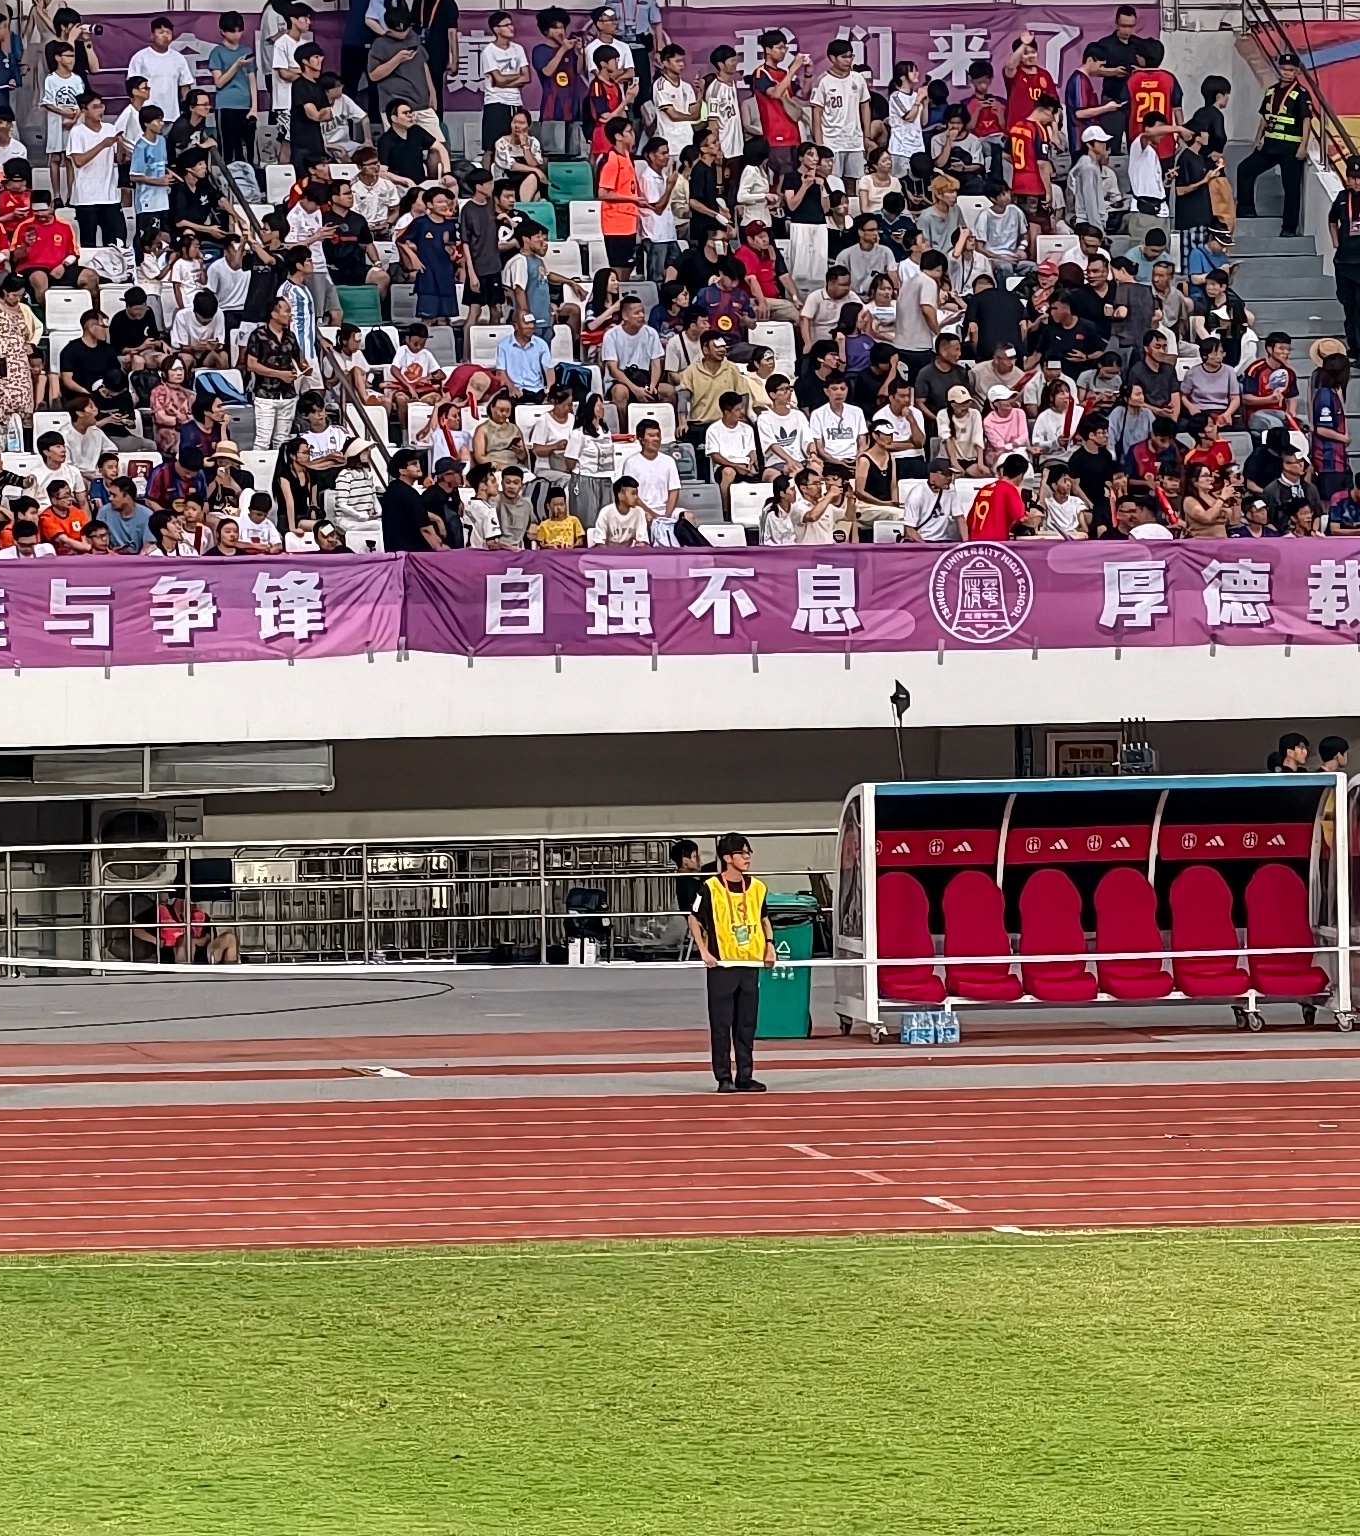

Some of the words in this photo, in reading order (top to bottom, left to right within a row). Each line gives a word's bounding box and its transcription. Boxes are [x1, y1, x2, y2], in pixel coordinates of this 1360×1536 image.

[1135, 92, 1165, 124] 20
[486, 563, 861, 635] 自强不息
